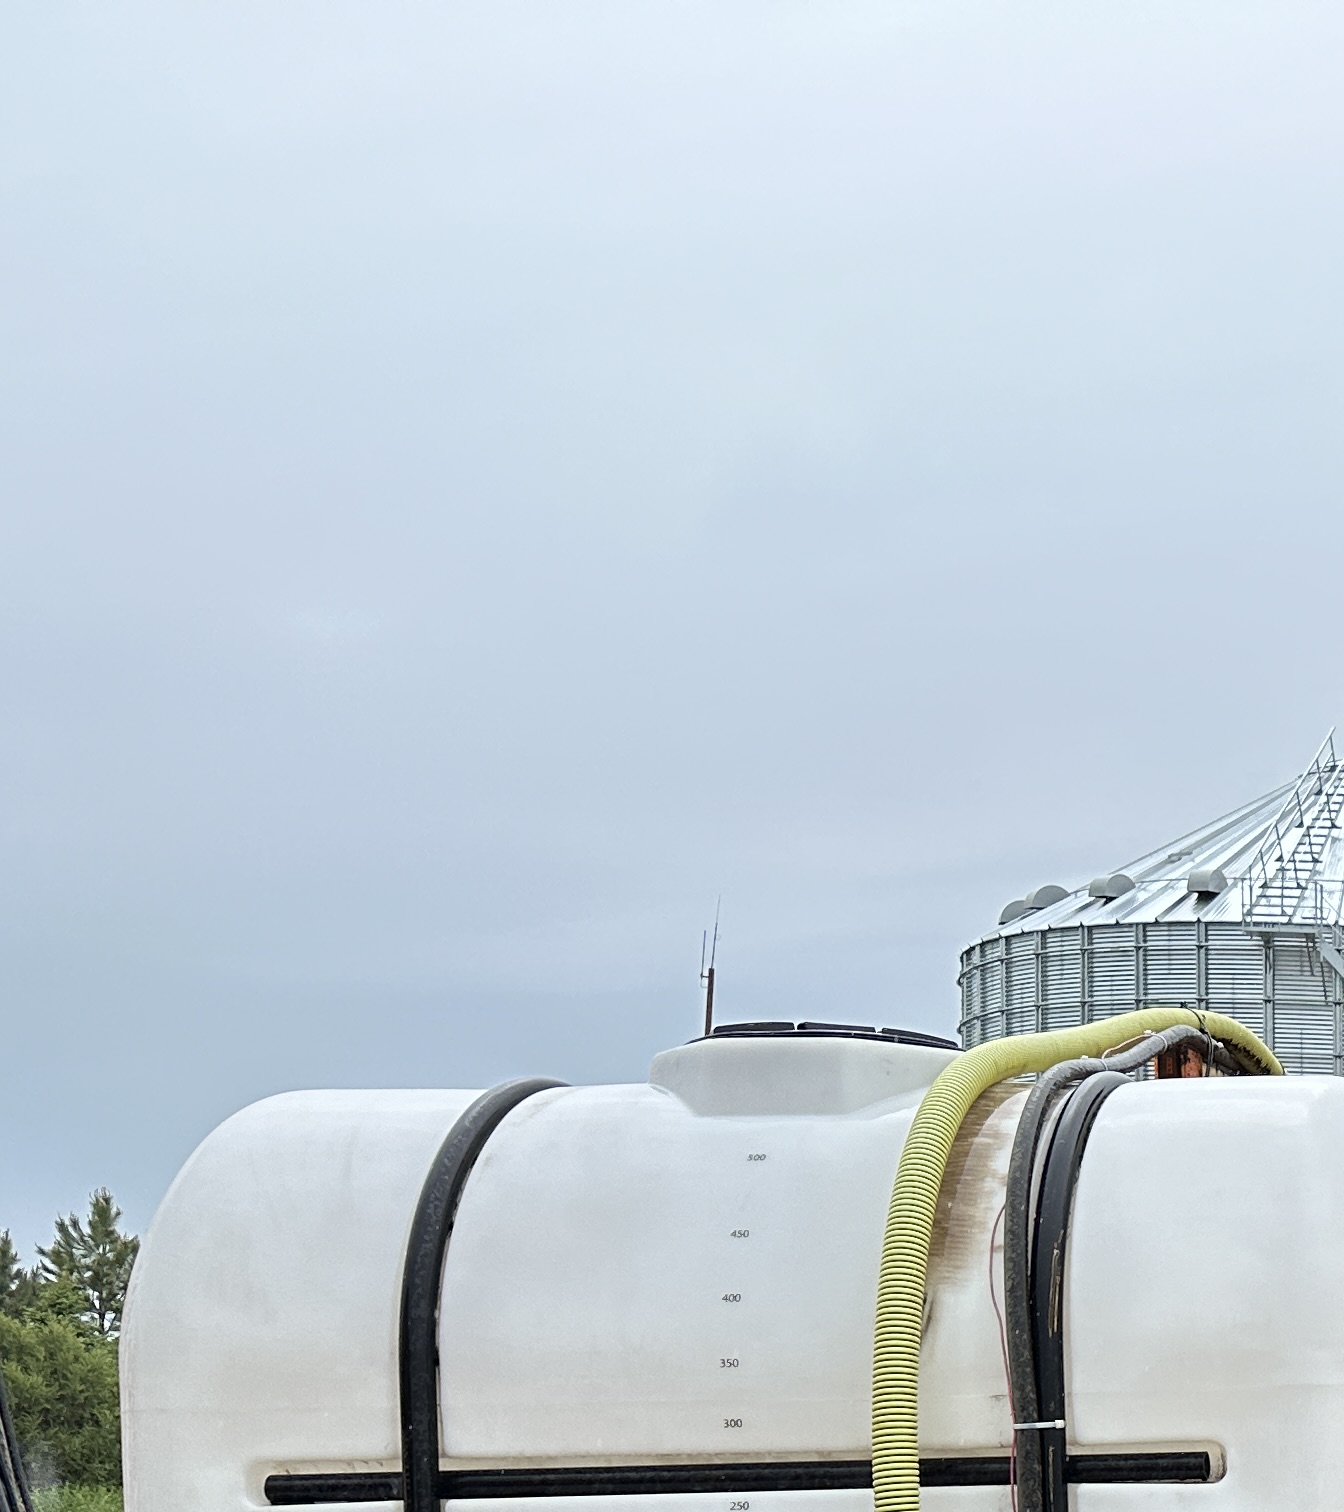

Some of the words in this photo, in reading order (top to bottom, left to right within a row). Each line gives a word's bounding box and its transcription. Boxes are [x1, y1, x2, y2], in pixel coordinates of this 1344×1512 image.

[746, 1153, 767, 1162] 500
[730, 1229, 750, 1239] 450
[721, 1293, 742, 1303] 400
[719, 1358, 740, 1369] 350
[723, 1418, 743, 1429] 300
[729, 1500, 750, 1511] 250
